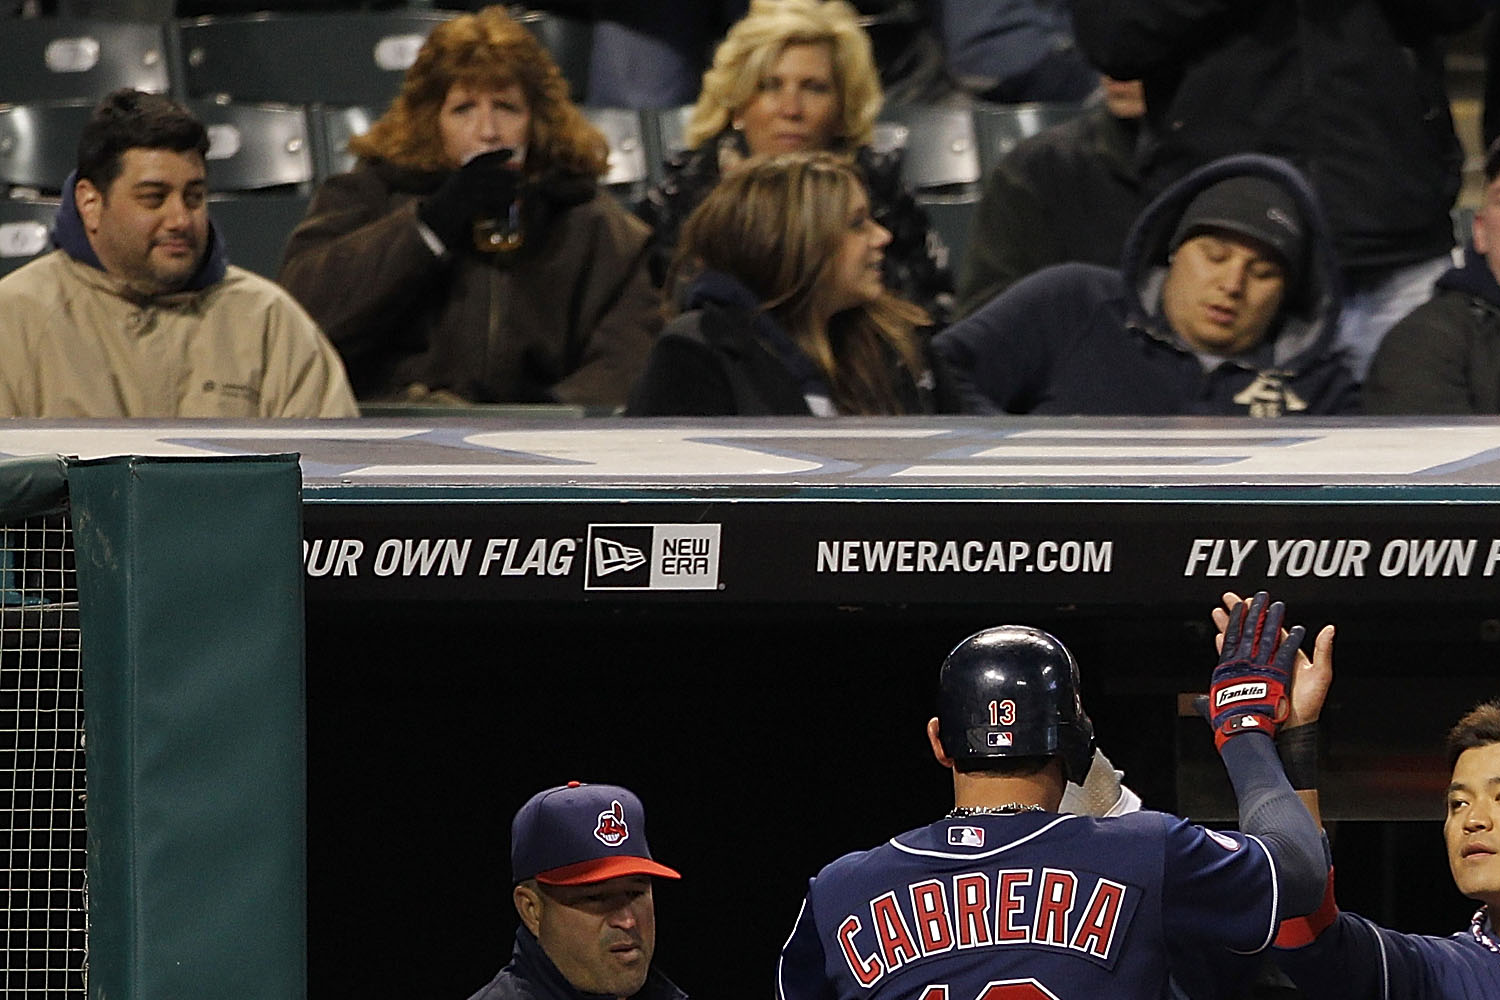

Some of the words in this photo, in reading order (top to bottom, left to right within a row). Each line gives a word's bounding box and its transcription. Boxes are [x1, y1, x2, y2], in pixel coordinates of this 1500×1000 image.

[303, 540, 364, 577] UR
[374, 539, 472, 577] OWN
[479, 539, 575, 577] FLAG
[663, 539, 709, 556] NEW
[817, 541, 1112, 572] NEWERACAP.COM
[1184, 539, 1258, 576] FLY
[1267, 540, 1370, 577] YOUR
[1380, 540, 1477, 577] OWN
[662, 557, 708, 575] ERA
[988, 699, 1016, 726] 13
[837, 867, 1127, 988] CABRERA
